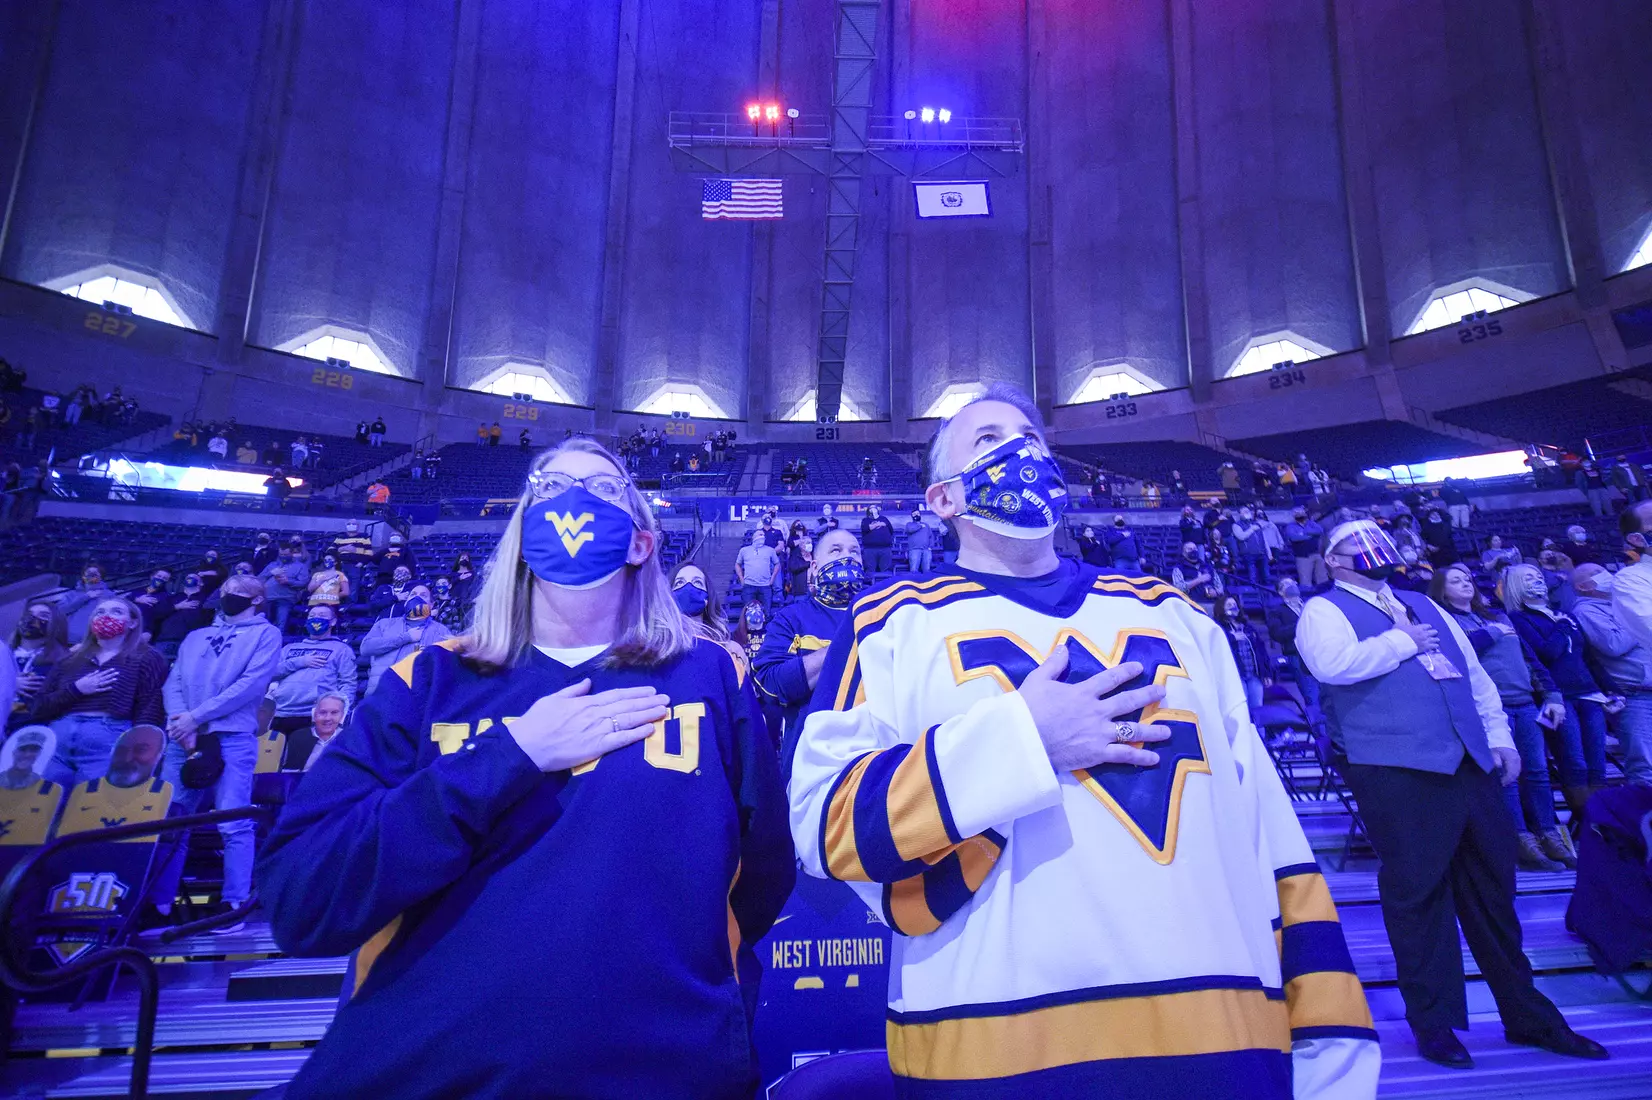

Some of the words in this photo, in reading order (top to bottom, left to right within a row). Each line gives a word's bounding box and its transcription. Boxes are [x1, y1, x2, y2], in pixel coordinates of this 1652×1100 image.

[84, 312, 138, 339] 227
[1458, 320, 1502, 344] 235
[312, 368, 353, 390] 228
[1268, 370, 1306, 389] 234
[503, 404, 539, 420] 229
[1105, 403, 1137, 419] 233
[665, 422, 696, 436] 230
[816, 428, 840, 440] 231
[1021, 488, 1046, 509] WEST
[772, 940, 812, 969] WEST
[817, 938, 884, 967] VIRGINIA
